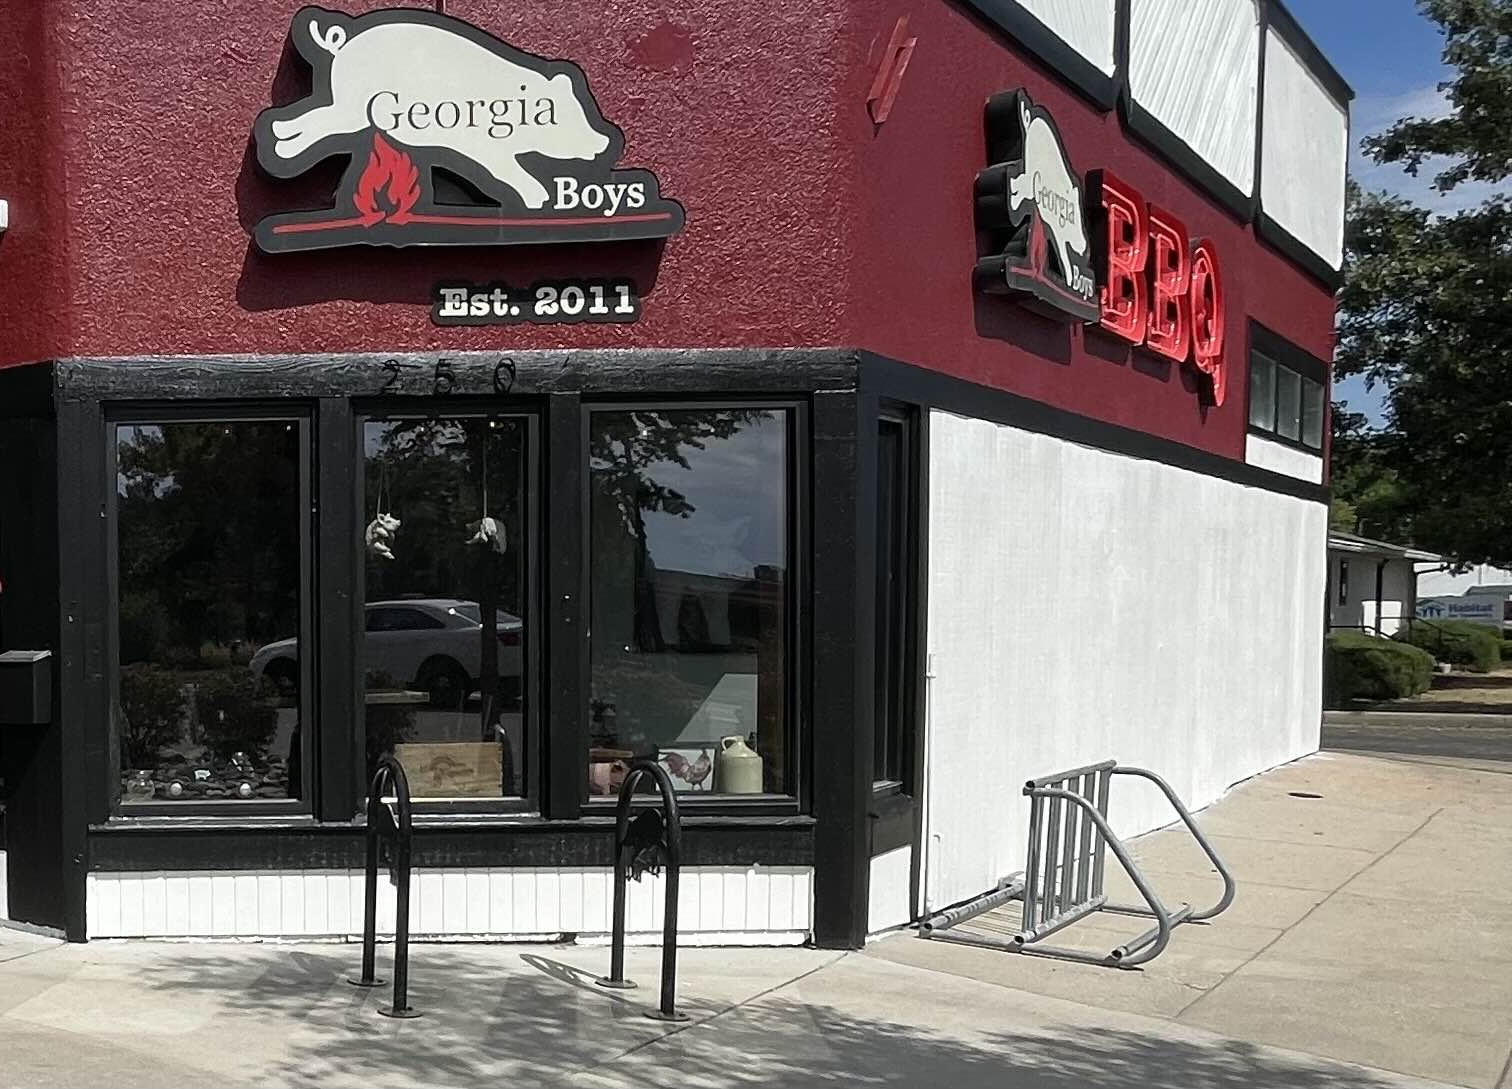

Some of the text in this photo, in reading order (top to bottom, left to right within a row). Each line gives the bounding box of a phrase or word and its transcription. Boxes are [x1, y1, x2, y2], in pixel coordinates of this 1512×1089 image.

[366, 85, 559, 139] Georgia
[553, 176, 646, 217] Boys
[1033, 170, 1076, 229] Georgia
[438, 285, 635, 317] Est. 2011
[1071, 264, 1095, 301] Boys
[1099, 169, 1226, 408] BBQ
